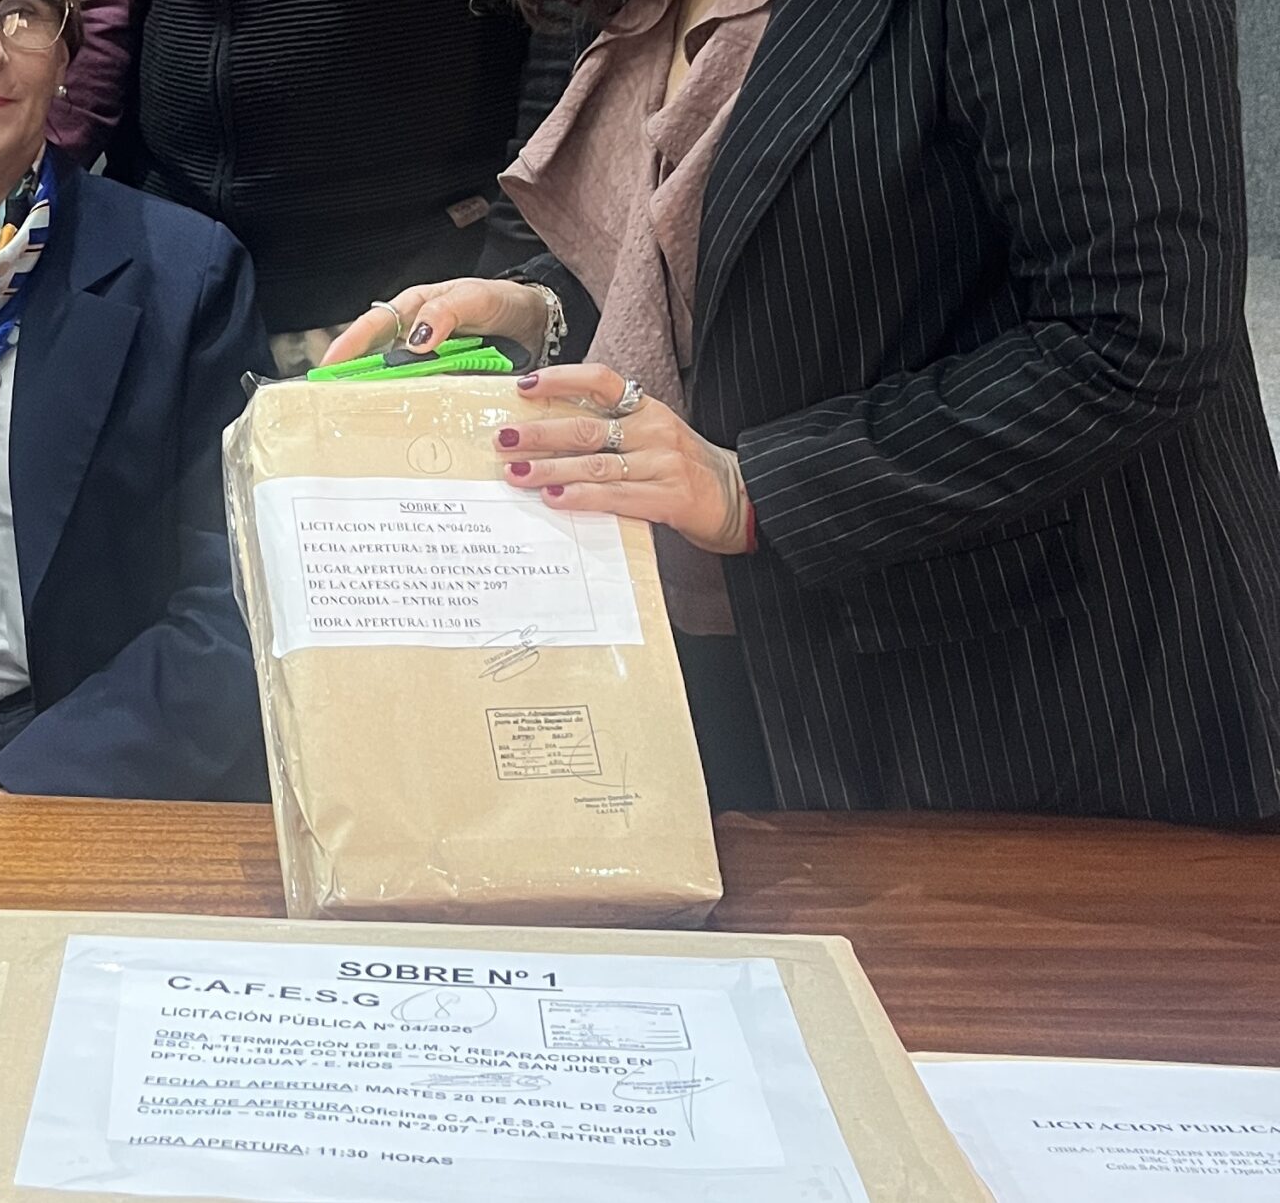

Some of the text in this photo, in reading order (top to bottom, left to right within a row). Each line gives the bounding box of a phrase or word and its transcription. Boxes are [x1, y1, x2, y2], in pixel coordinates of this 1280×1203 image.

[399, 502, 441, 513] SOBRE
[460, 503, 466, 512] 1
[300, 521, 376, 532] LICITACION
[380, 522, 434, 532] PUBLICA
[303, 543, 346, 552] FECHA
[350, 543, 422, 553] APERTURA:
[426, 544, 438, 553] 28
[440, 544, 458, 554] DE
[462, 545, 500, 554] ABRIL
[306, 564, 570, 575] LUGAR APERTURA: OFICINAS CENTRALES
[309, 580, 326, 589] DE
[329, 580, 346, 589] LA
[349, 580, 400, 590] CAFESG
[403, 581, 428, 590] SAN
[431, 581, 464, 590] JUAN
[484, 581, 508, 590] 2097
[310, 596, 390, 605] CONCORDIA
[402, 596, 444, 606] ENTRE
[448, 597, 479, 606] RIOS
[313, 617, 481, 628] HORA APERTURA: 11:30 HS
[338, 960, 475, 985] SOBRE
[541, 972, 557, 987] 1
[168, 975, 381, 1008] C.A.F.E.S.G
[161, 1006, 272, 1024] LICITACIÓN
[279, 1013, 367, 1031] PÚBLICA
[400, 1024, 473, 1035] 04/2026
[151, 1050, 206, 1063] DPTO.
[213, 1055, 307, 1066] URUGUAY
[324, 1060, 341, 1068] E.
[347, 1059, 393, 1070] RÍOS
[153, 1038, 195, 1050] ESC.
[310, 1049, 402, 1059] OCTUBRE
[424, 1053, 511, 1068] COLONIA
[518, 1061, 558, 1072] SAN
[563, 1064, 628, 1075] JUSTO
[221, 1034, 349, 1049] TERMINACIÓN
[449, 1045, 461, 1053] Y
[468, 1047, 620, 1065] REPARACIONES
[626, 1057, 653, 1066] EN
[144, 1075, 658, 1114] FECHA DE APERTURA: MARTES 28 DE ABRIL DE 2026
[136, 1105, 232, 1116] Concordia
[254, 1109, 297, 1118] calle
[304, 1111, 340, 1122] San
[346, 1115, 391, 1127] Juan
[622, 1135, 672, 1147] RÍOS
[139, 1095, 208, 1107] LUGAR
[213, 1098, 240, 1107] DE
[444, 1113, 555, 1129] C.A.F.E.S.G
[578, 1123, 647, 1136] Ciudad
[653, 1127, 677, 1137] de
[1032, 1119, 1174, 1133] LICITACION
[128, 1135, 454, 1166] HORA APERTURA: 11:30 HORAS
[1096, 1146, 1204, 1157] TERMINACION
